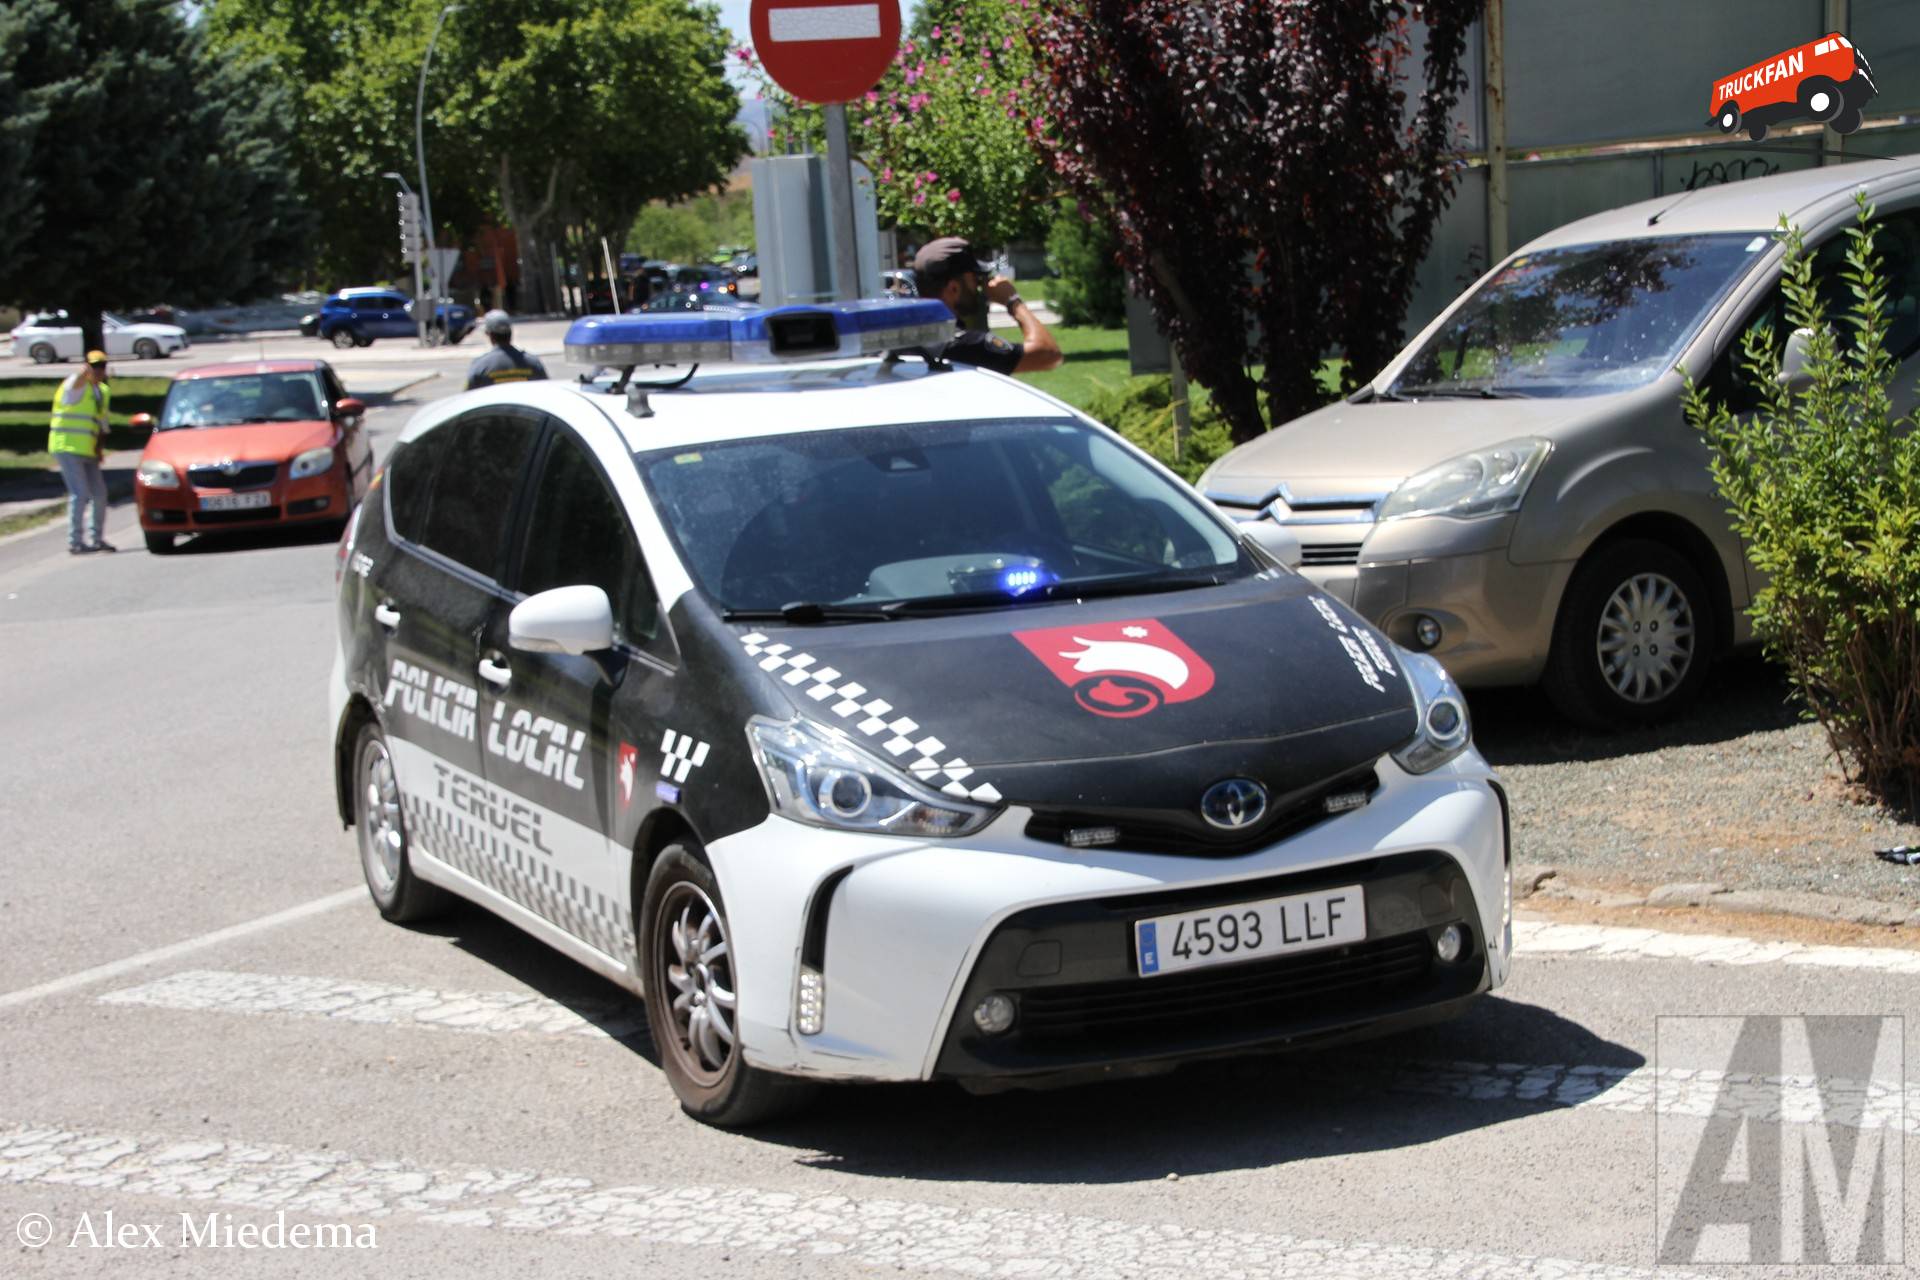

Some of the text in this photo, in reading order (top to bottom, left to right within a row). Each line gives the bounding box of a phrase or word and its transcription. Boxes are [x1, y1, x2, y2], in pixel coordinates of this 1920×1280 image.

[384, 659, 586, 790] POLICIA LOCAL
[434, 762, 553, 856] TERUEL
[1172, 897, 1346, 960] 4593 LLF
